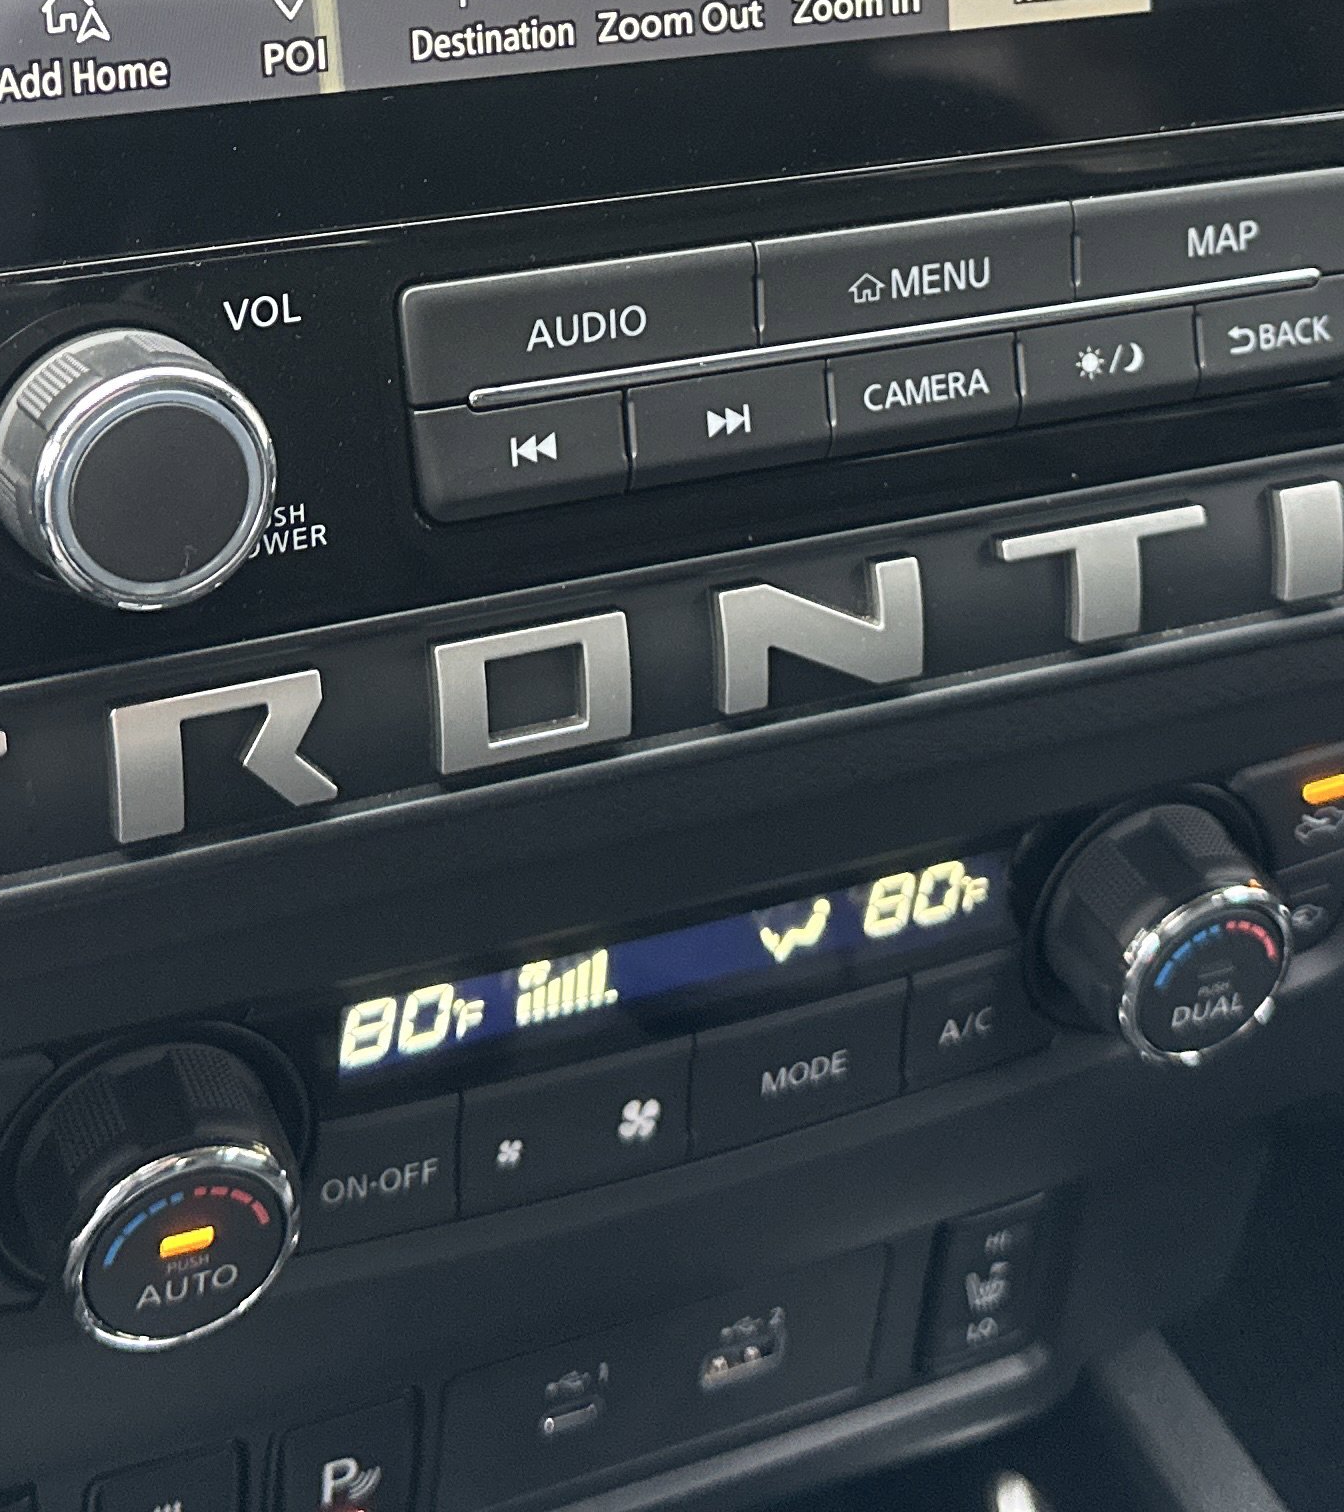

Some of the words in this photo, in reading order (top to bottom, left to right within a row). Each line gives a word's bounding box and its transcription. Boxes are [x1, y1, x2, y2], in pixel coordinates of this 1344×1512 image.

[411, 16, 576, 62] Destination
[596, 9, 694, 45] Zoom
[72, 57, 170, 95] Home
[262, 37, 328, 78] POI
[1186, 219, 1259, 259] MAP
[890, 257, 991, 300] MENU
[223, 292, 303, 332] VOL
[526, 304, 648, 352] AUDIO
[1258, 314, 1333, 351] BACK
[863, 368, 990, 413] CAMERA
[938, 1004, 993, 1047] A/C
[1171, 992, 1244, 1031] DUAL
[760, 1048, 848, 1097] MODE
[166, 1253, 210, 1274] PUSH
[136, 1263, 239, 1310] AUTO
